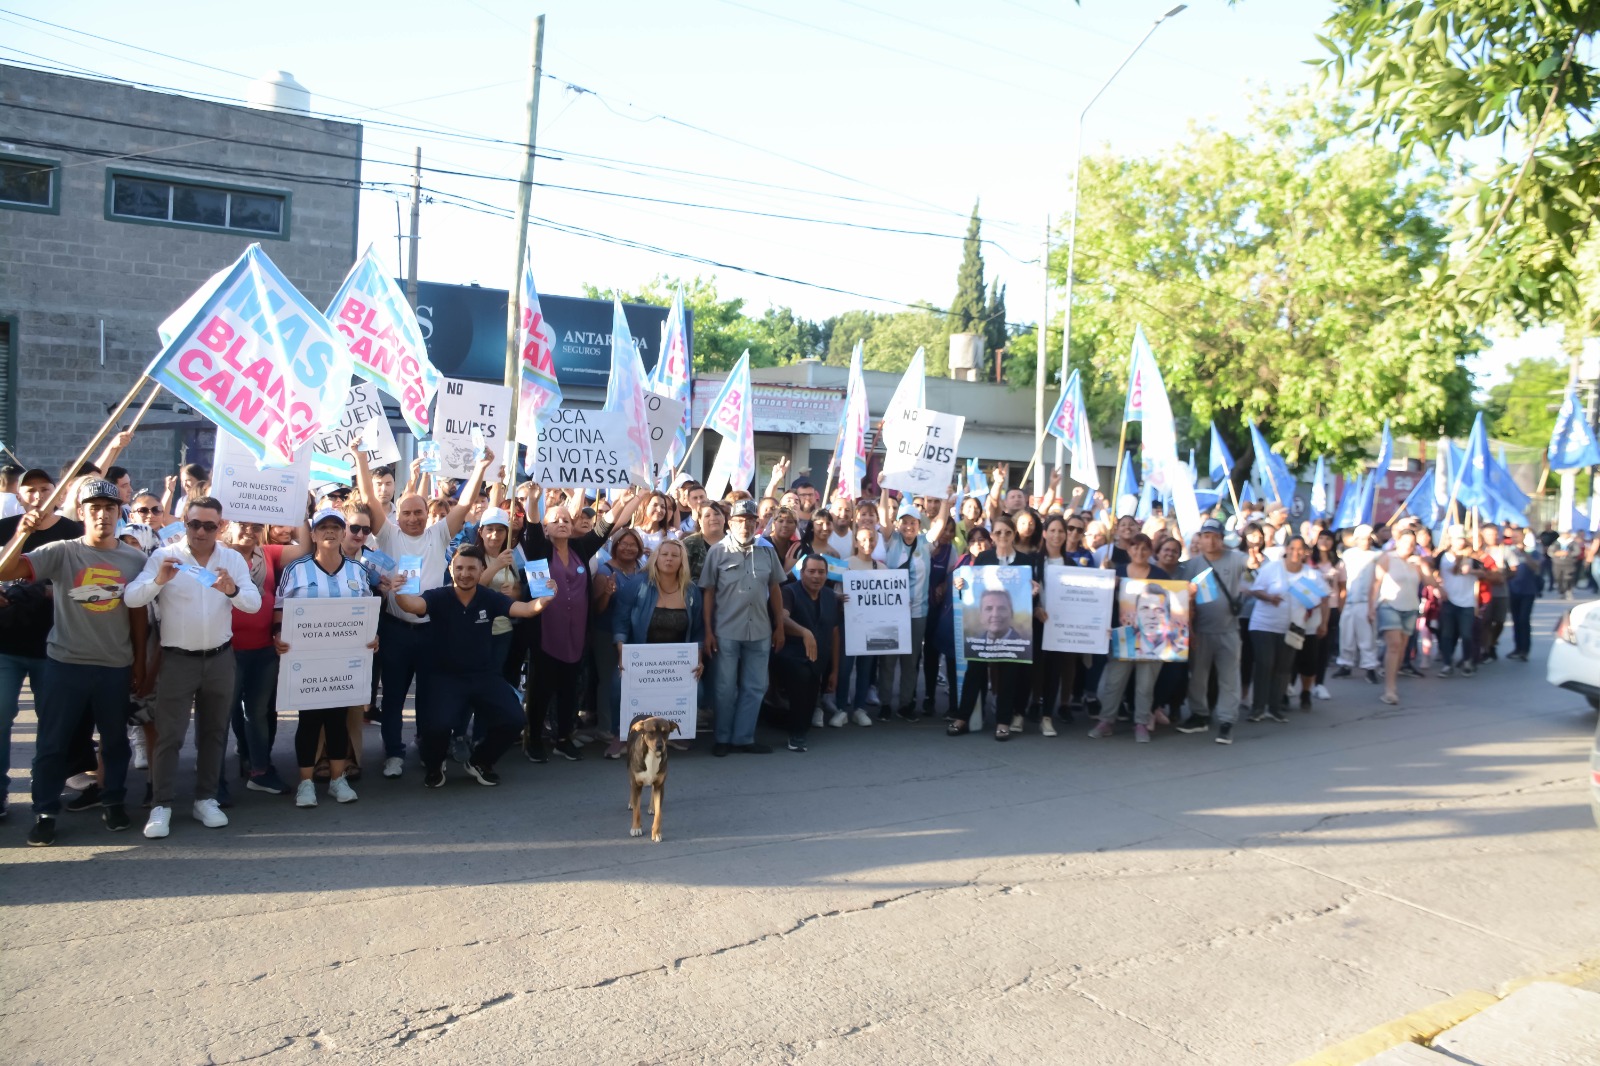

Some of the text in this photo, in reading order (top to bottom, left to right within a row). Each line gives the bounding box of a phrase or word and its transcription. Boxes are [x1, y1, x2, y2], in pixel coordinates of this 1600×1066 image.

[562, 345, 601, 356] SEGUROS
[446, 381, 464, 396] NO
[751, 398, 787, 408] OMIDAS
[479, 403, 496, 417] TE
[902, 409, 918, 421] NO
[550, 409, 586, 424] OCA
[537, 427, 605, 444] BOCINA
[926, 425, 941, 438] TE
[537, 446, 618, 466] SI VOTAS
[540, 466, 630, 485] A MASSA
[232, 480, 287, 493] POR NUESTROS
[238, 492, 278, 502] JUBILADOS
[229, 501, 250, 510] VOTA
[258, 504, 284, 513] MASSA
[323, 620, 364, 628] EDUCACION
[302, 631, 323, 639] VOTA
[332, 630, 358, 638] MASSA
[329, 674, 353, 682] SALUD
[299, 683, 355, 694] VOTA A MASSA
